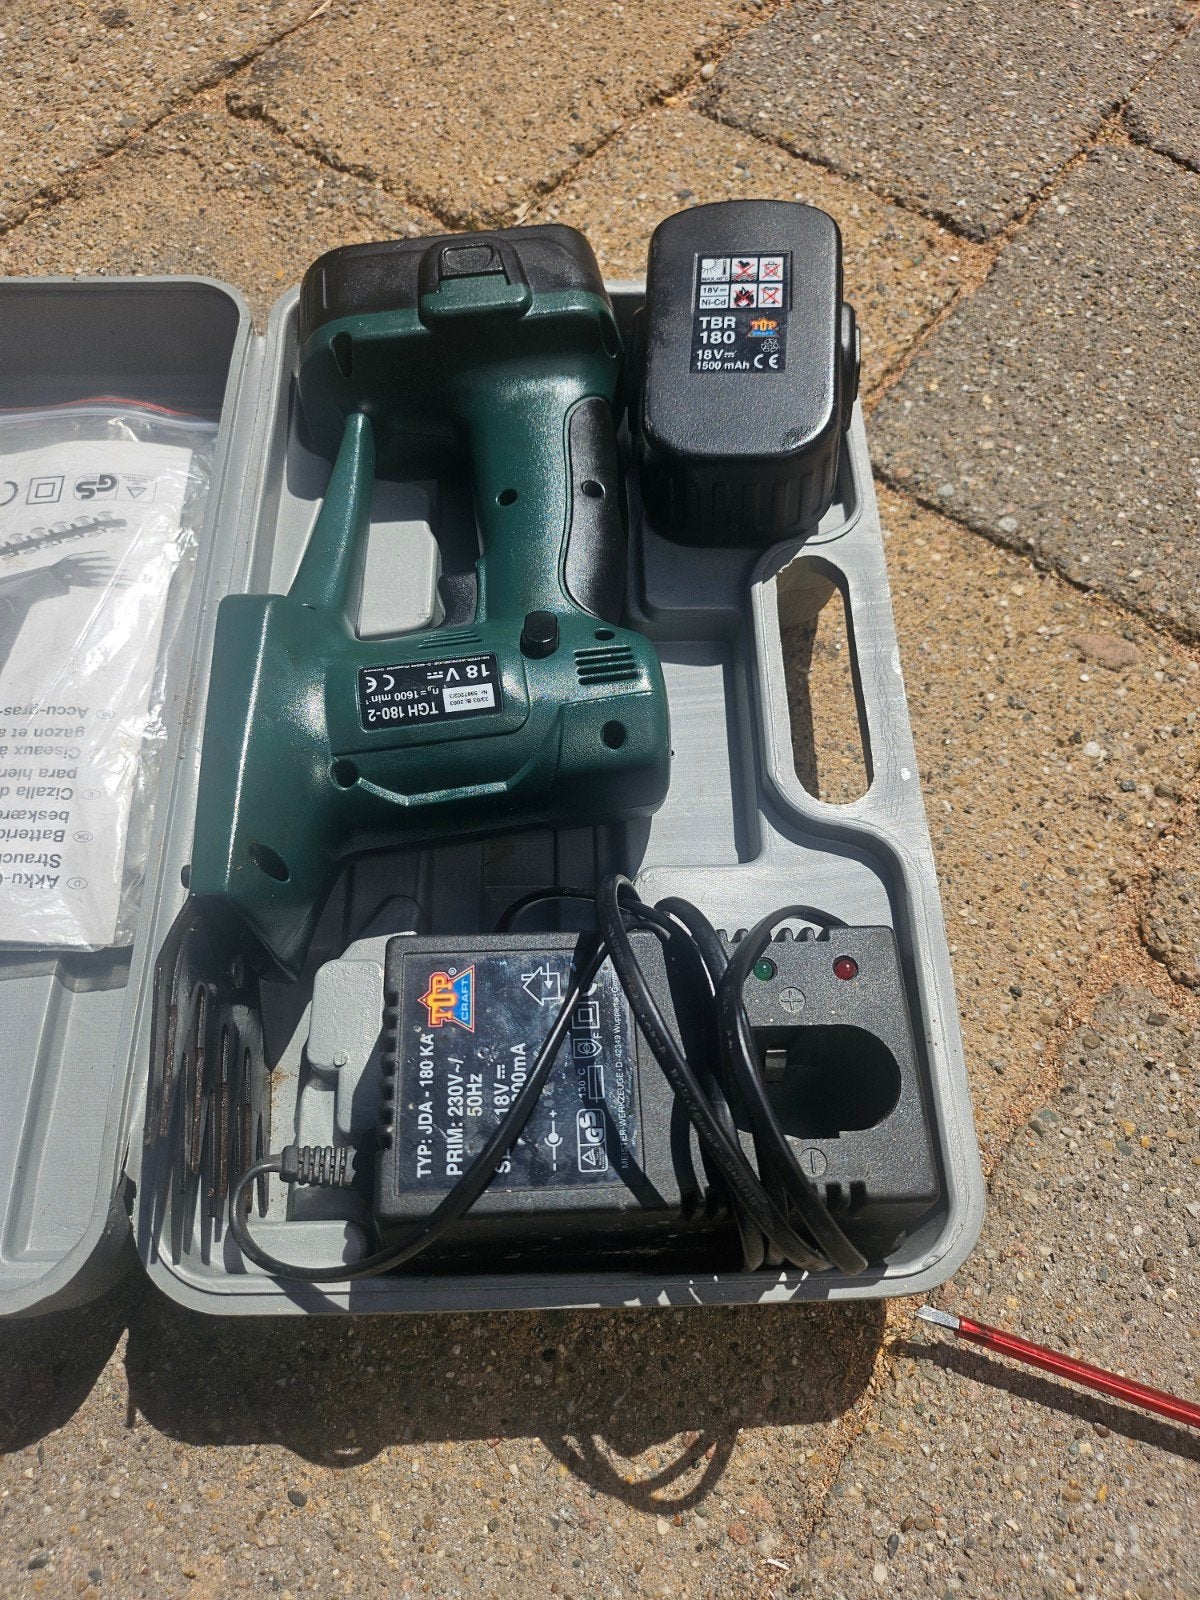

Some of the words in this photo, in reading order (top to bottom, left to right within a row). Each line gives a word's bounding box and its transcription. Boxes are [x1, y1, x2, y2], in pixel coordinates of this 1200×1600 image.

[699, 316, 736, 329] TBR
[750, 318, 777, 331] TOP
[700, 331, 736, 344] 180
[697, 349, 724, 360] 18V
[697, 362, 722, 370] 1500
[724, 361, 749, 370] mAh
[466, 664, 490, 678] 18
[368, 706, 405, 721] 180-2
[408, 701, 439, 716] TGH
[12, 728, 27, 739] et
[34, 726, 85, 738] gazon
[15, 745, 81, 759] Ciseaux
[0, 768, 33, 780] hier
[39, 767, 78, 779] para
[16, 786, 73, 800] Cizalla
[0, 853, 62, 868] Strauc
[0, 873, 60, 889] Akku-
[426, 972, 457, 1026] TOP
[461, 979, 469, 1021] CRAFT
[420, 1034, 434, 1056] KA
[419, 1060, 434, 1086] 180
[467, 1073, 483, 1117] 50Hz
[493, 1083, 510, 1115] 18V
[417, 1101, 433, 1134] JDA
[580, 1111, 604, 1143] GS
[447, 1122, 463, 1176] PRIM:
[417, 1139, 433, 1178] TYP:
